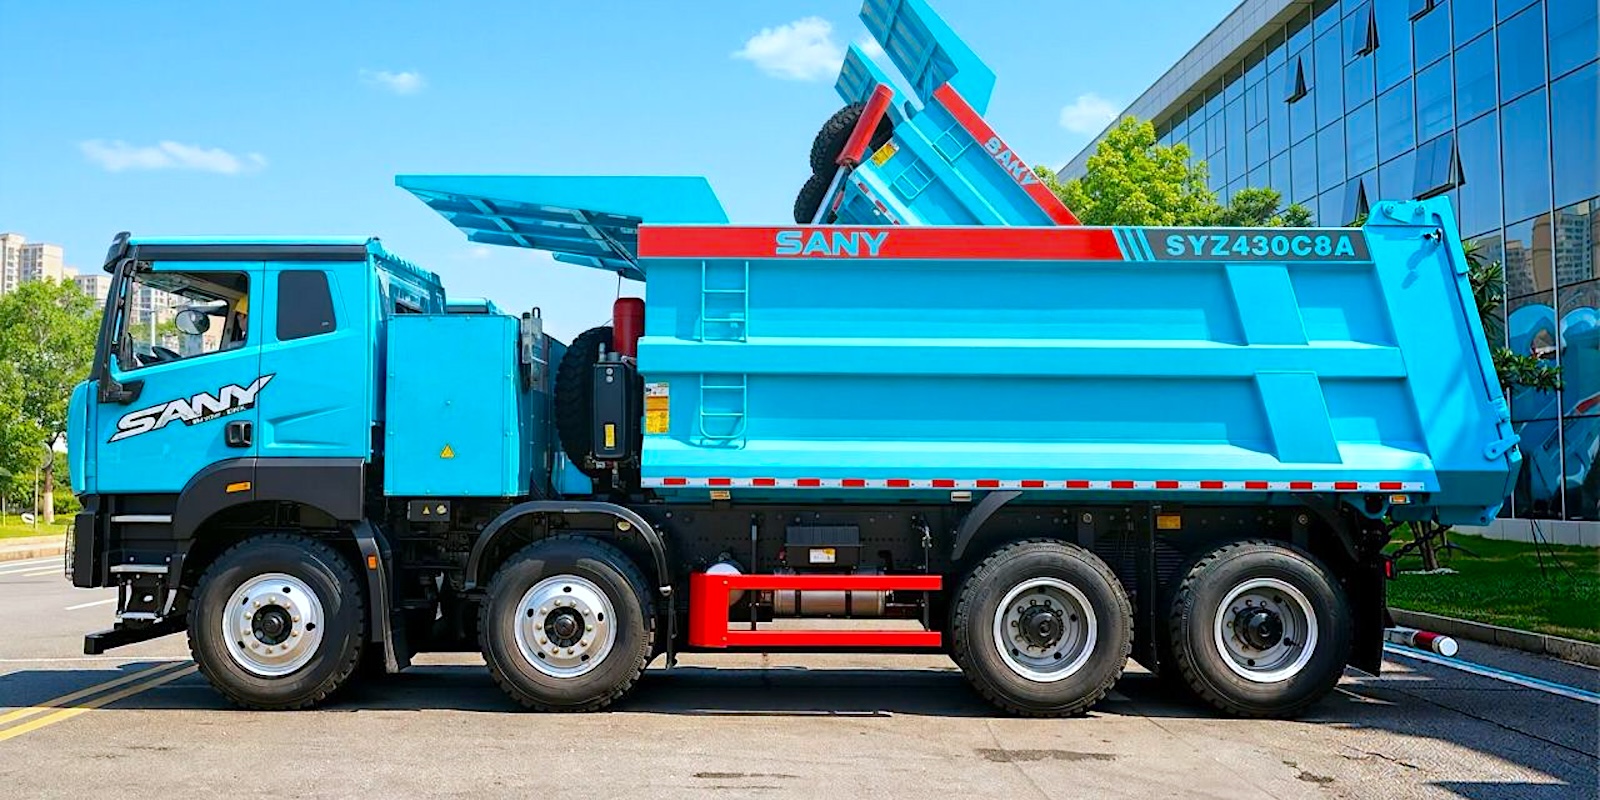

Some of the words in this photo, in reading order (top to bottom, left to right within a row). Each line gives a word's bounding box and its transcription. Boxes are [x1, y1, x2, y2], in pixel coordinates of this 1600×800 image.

[775, 230, 889, 256] SANY
[1165, 234, 1355, 256] SYZ430C8A
[107, 373, 276, 443] SANY
